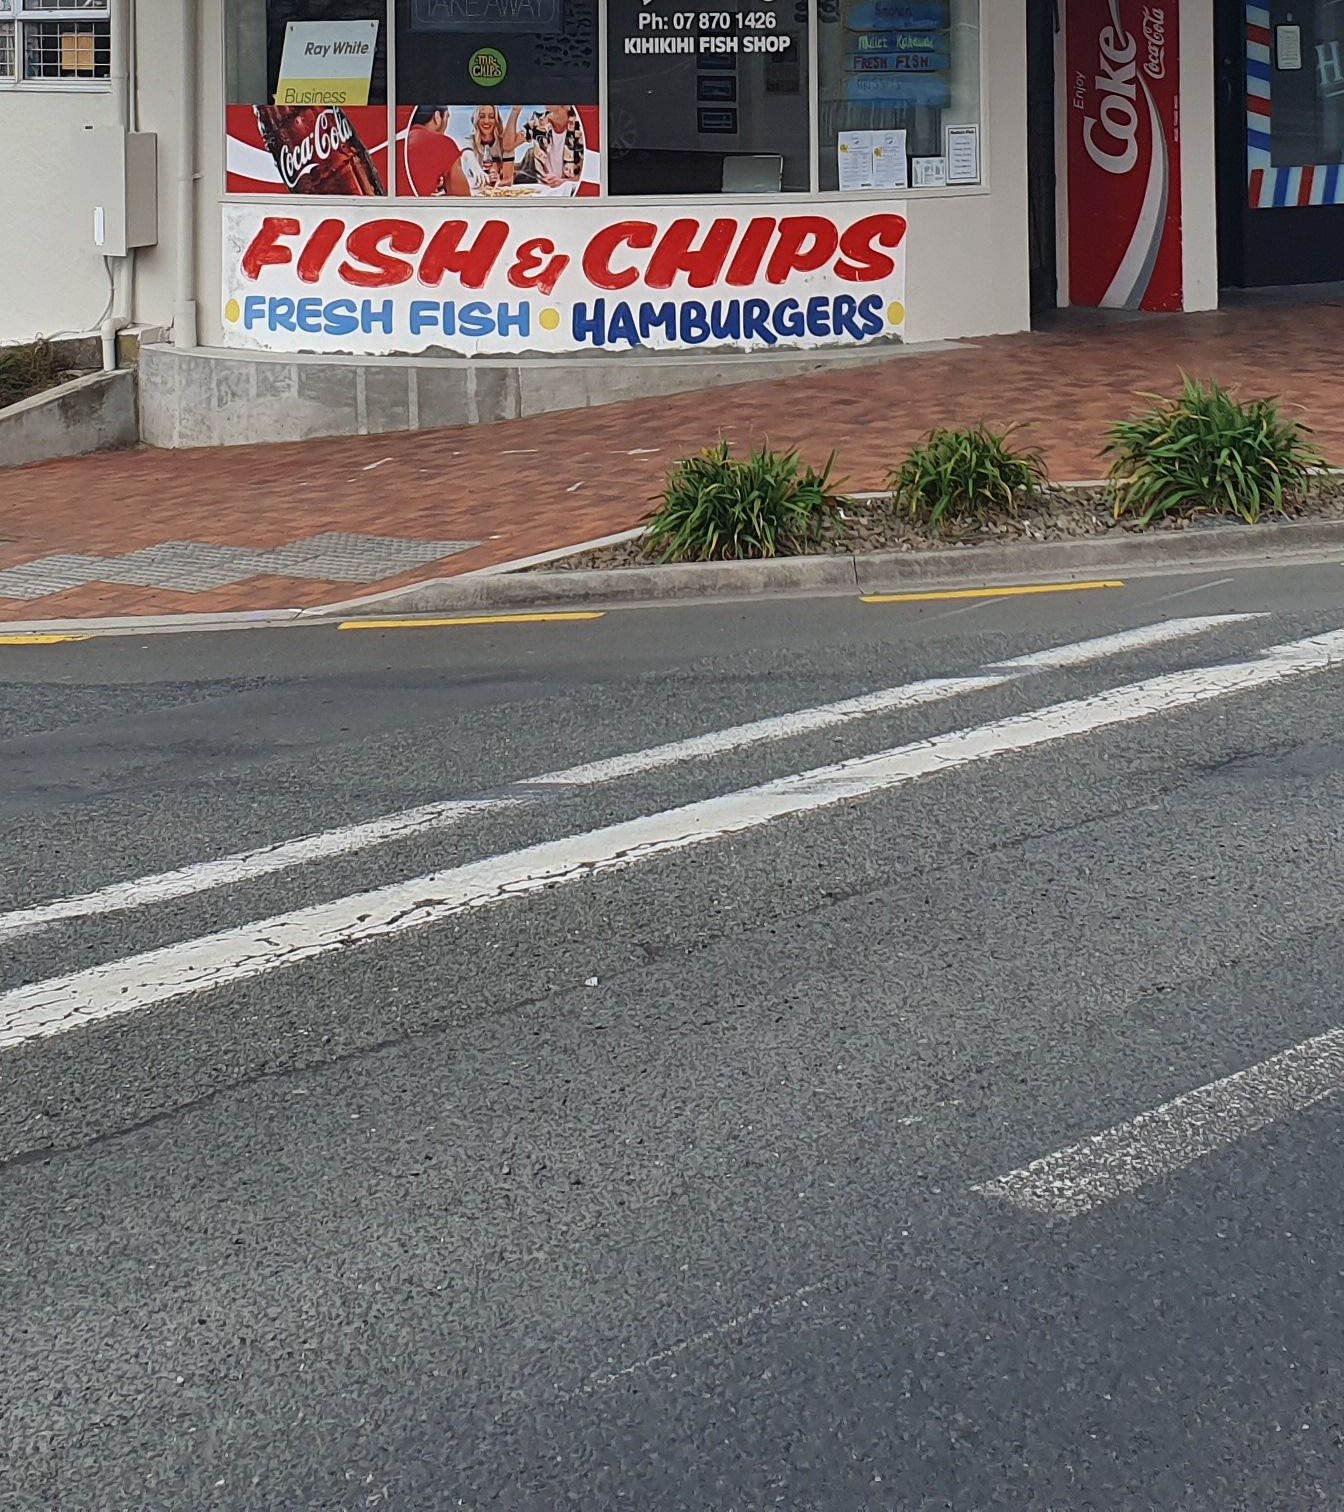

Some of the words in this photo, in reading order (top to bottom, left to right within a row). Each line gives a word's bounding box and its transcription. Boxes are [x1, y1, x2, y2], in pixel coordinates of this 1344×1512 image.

[638, 13, 669, 32] Ph:
[673, 13, 695, 30] 07
[698, 13, 731, 30] 870
[734, 11, 777, 29] 1426
[304, 41, 331, 57] Ray
[333, 40, 370, 55] White
[624, 37, 695, 55] KIHIKIHI
[699, 36, 739, 53] FISH
[743, 35, 791, 52] SHOP
[853, 55, 888, 69] FRESH
[896, 54, 929, 69] FISH
[284, 88, 347, 104] Business
[1072, 71, 1087, 110] Enjoy
[1083, 25, 1139, 175] Coke
[280, 108, 353, 188] Coca-Cola
[241, 217, 510, 289] FISH
[508, 239, 570, 296] &
[582, 213, 907, 290] CHIPS
[243, 296, 394, 337] FRESH
[409, 298, 531, 338] FISH
[572, 293, 885, 348] HAMBURGERS
